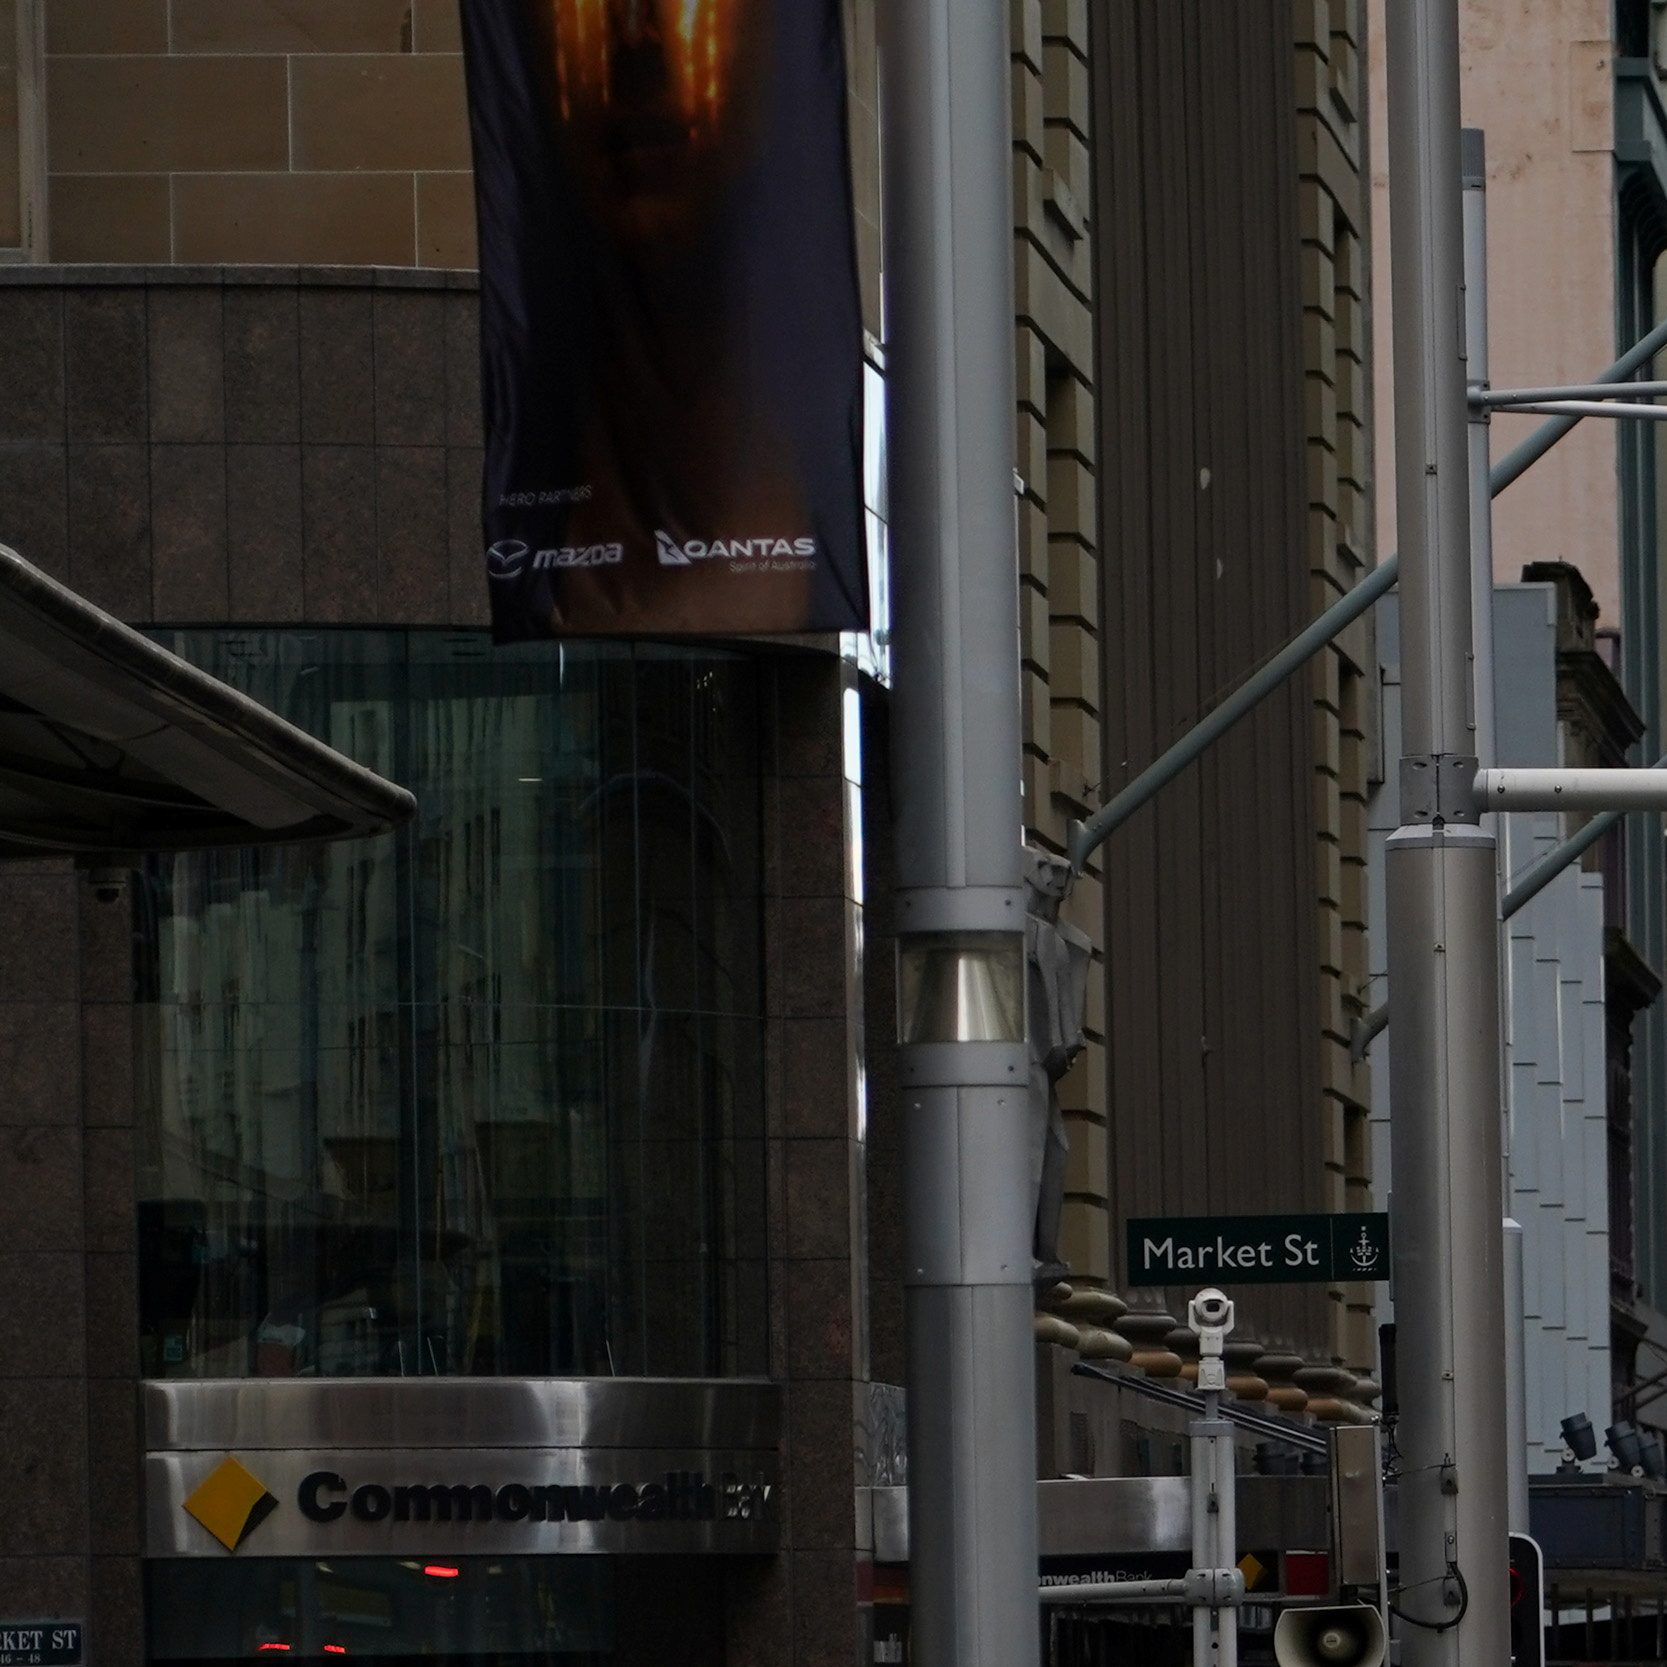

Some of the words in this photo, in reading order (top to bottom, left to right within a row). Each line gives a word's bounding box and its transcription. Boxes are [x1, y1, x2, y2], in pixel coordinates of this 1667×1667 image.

[532, 542, 624, 569] mazda
[683, 538, 817, 557] QANTAS
[1143, 1235, 1273, 1270] Market
[1284, 1233, 1320, 1267] St
[52, 1630, 77, 1650] ST
